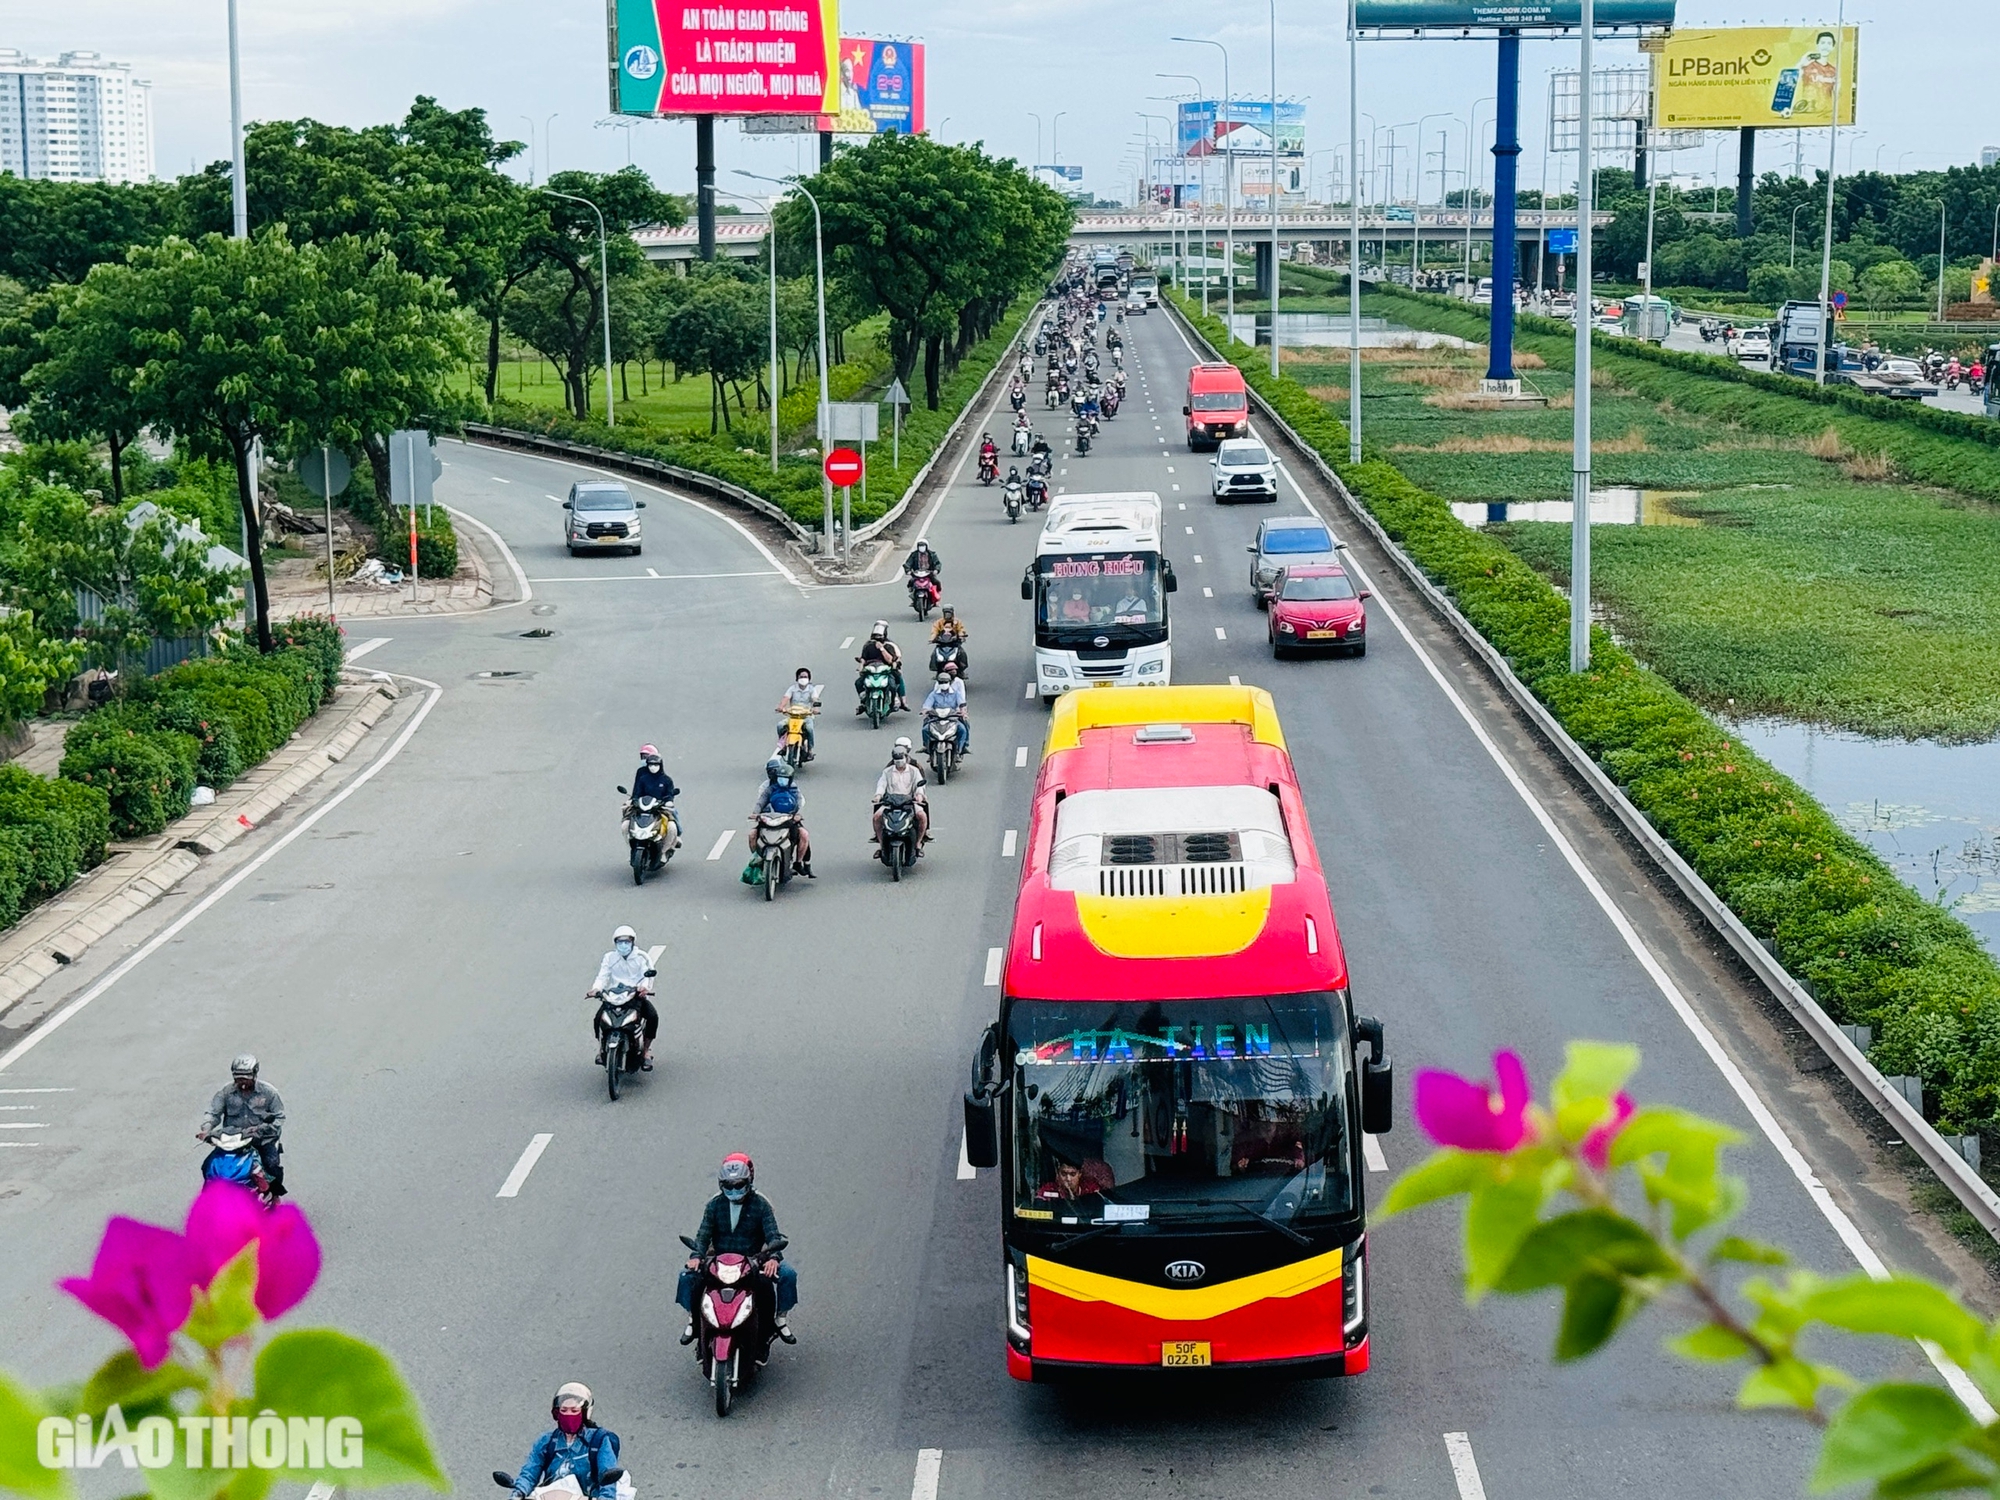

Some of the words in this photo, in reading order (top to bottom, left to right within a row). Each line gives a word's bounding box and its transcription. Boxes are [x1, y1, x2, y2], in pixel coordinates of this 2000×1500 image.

[682, 8, 700, 30] AN
[702, 5, 735, 30] TOÀN
[737, 9, 766, 31] GIAO
[768, 6, 809, 32] THÔNG
[695, 37, 712, 62] LÀ
[713, 37, 754, 63] TRÁCH
[756, 38, 796, 68] NHIỆM
[1669, 56, 1750, 76] LPBank
[671, 66, 697, 95] CỦA
[699, 73, 724, 100] MỌI
[726, 68, 768, 98] NGƯỜI,
[770, 73, 794, 100] MỌI
[796, 70, 822, 96] NHÀ
[877, 74, 903, 91] 2-9
[1171, 1265, 1199, 1277] KIA
[1175, 1343, 1196, 1354] 50F
